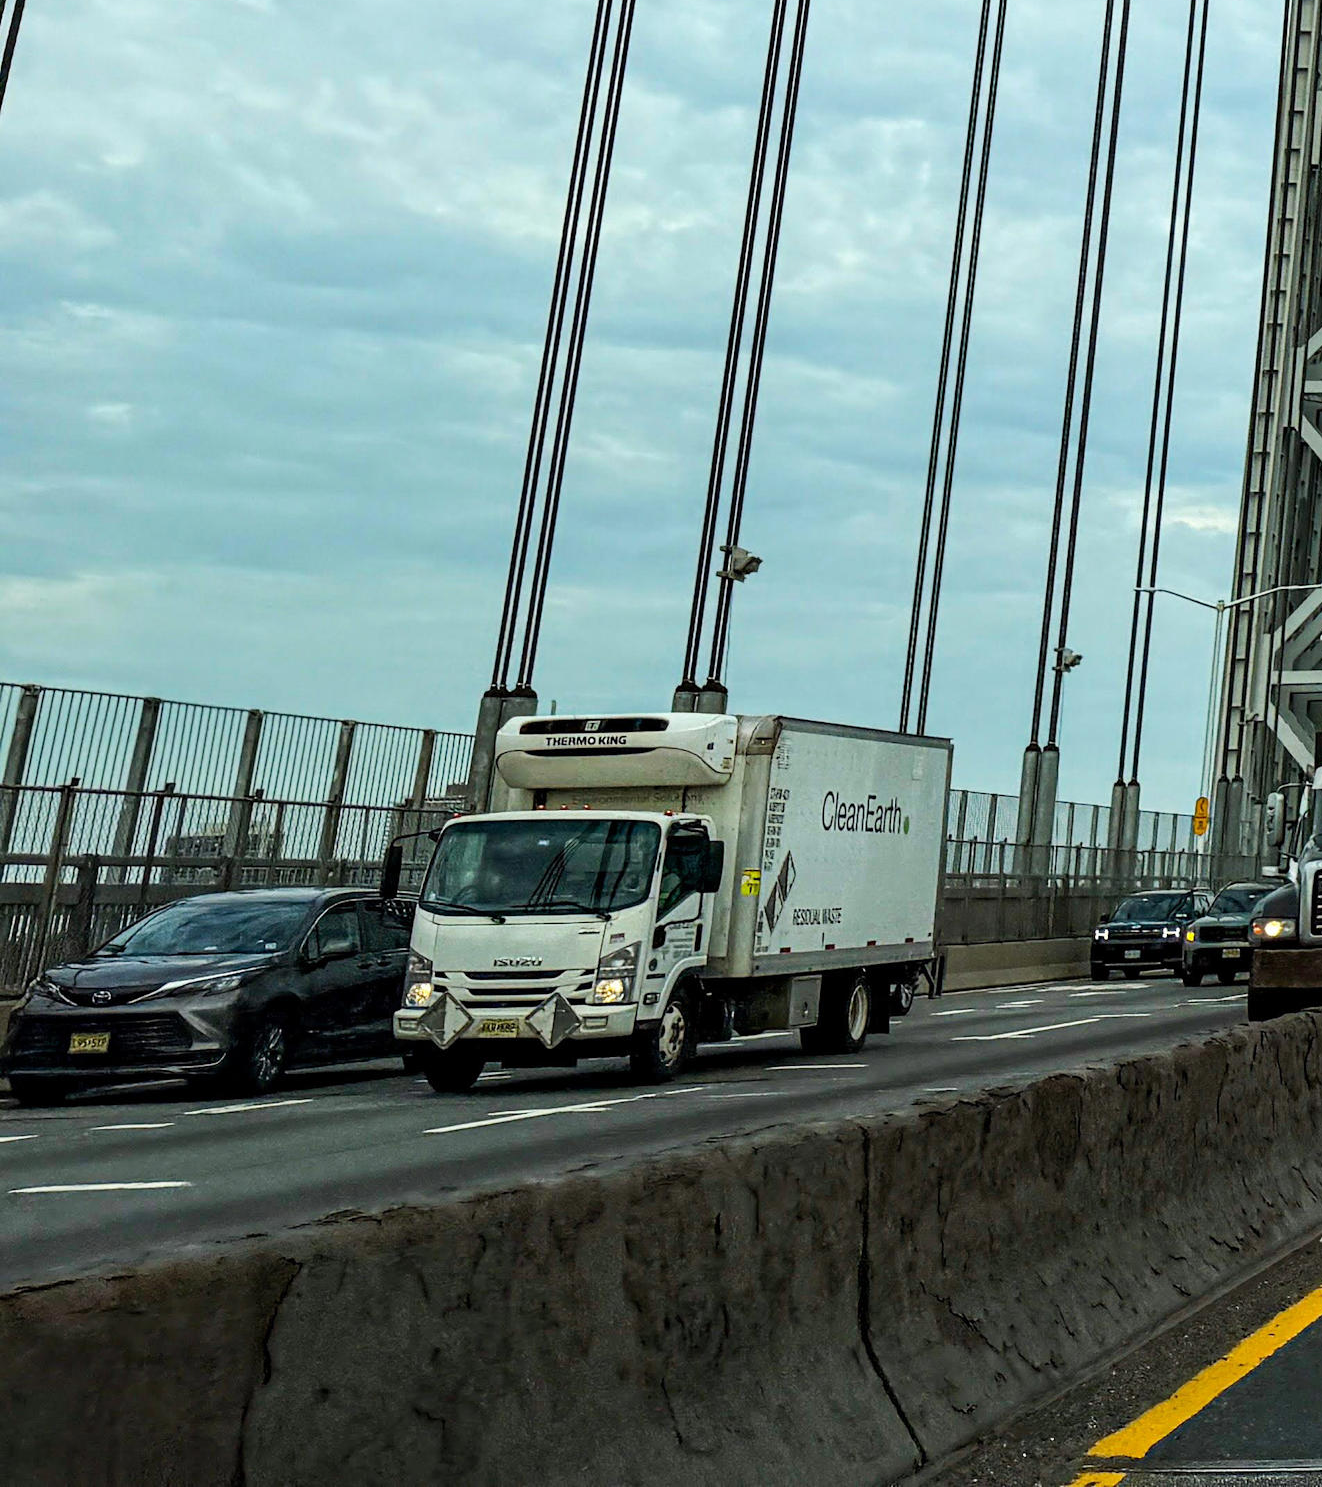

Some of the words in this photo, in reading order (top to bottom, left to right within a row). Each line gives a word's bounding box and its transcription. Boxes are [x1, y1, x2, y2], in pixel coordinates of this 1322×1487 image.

[545, 736, 596, 746] THERMO
[598, 735, 627, 745] KING
[821, 790, 902, 834] CleanEarth
[493, 957, 543, 967] ISUZU
